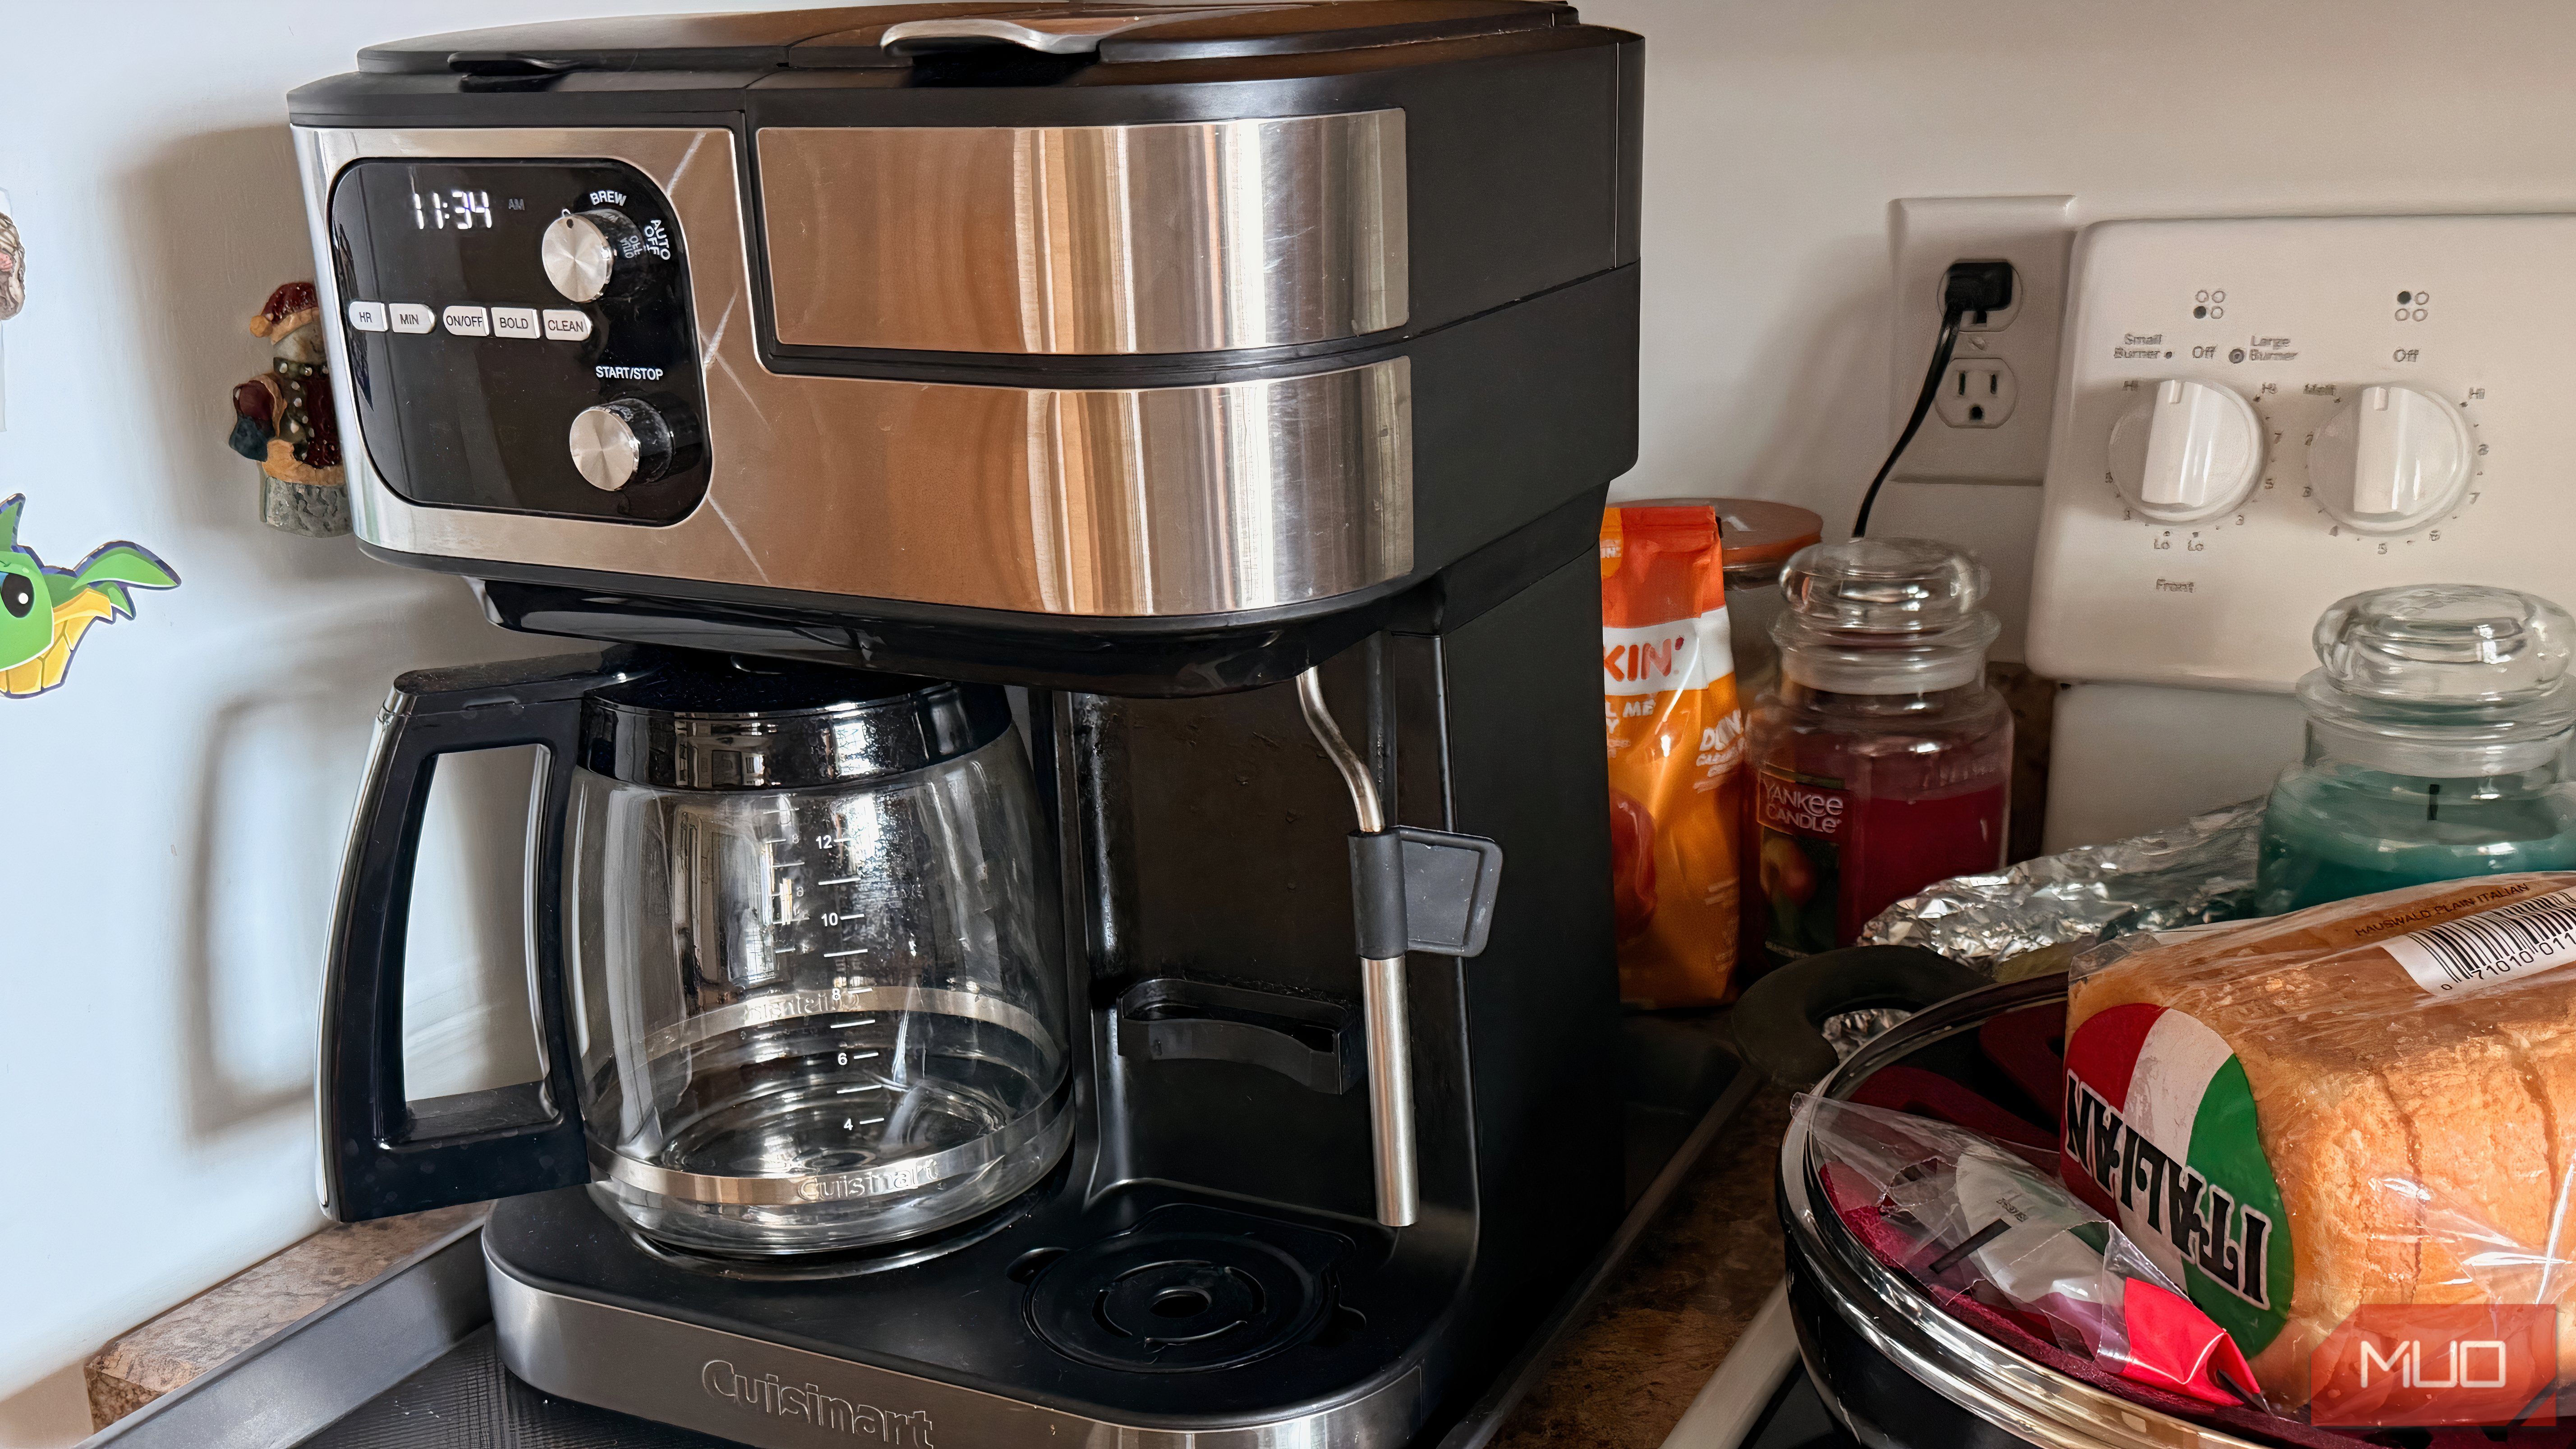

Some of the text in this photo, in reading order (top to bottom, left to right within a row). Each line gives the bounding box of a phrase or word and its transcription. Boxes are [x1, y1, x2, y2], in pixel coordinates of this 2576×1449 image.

[589, 190, 626, 206] BREW
[414, 191, 525, 230] 11:34 AM
[644, 225, 660, 256] OFF
[650, 219, 671, 260] AUTO
[359, 312, 371, 323] HR
[400, 314, 419, 325] MIN
[446, 315, 483, 328] ON/OFF
[499, 317, 529, 329] BOLD
[547, 319, 584, 332] CLEAN
[2124, 333, 2162, 345] Small
[2114, 347, 2161, 359] Burner
[2192, 344, 2218, 359] Off
[2392, 348, 2420, 362] Off
[595, 365, 663, 381] START/STOP
[2156, 579, 2194, 593] Front
[815, 834, 833, 849] 12
[2354, 883, 2530, 936] HAUSWALD PLAIN ITALIAN
[821, 912, 839, 927] 10
[2471, 950, 2535, 980] 71010
[832, 988, 841, 1001] 8
[837, 1052, 848, 1066] 6
[843, 1118, 853, 1131] 4
[797, 1158, 938, 1201] Cuisinart
[2065, 1070, 2270, 1308] ITALIAN
[702, 1359, 934, 1449] Cuisinart
